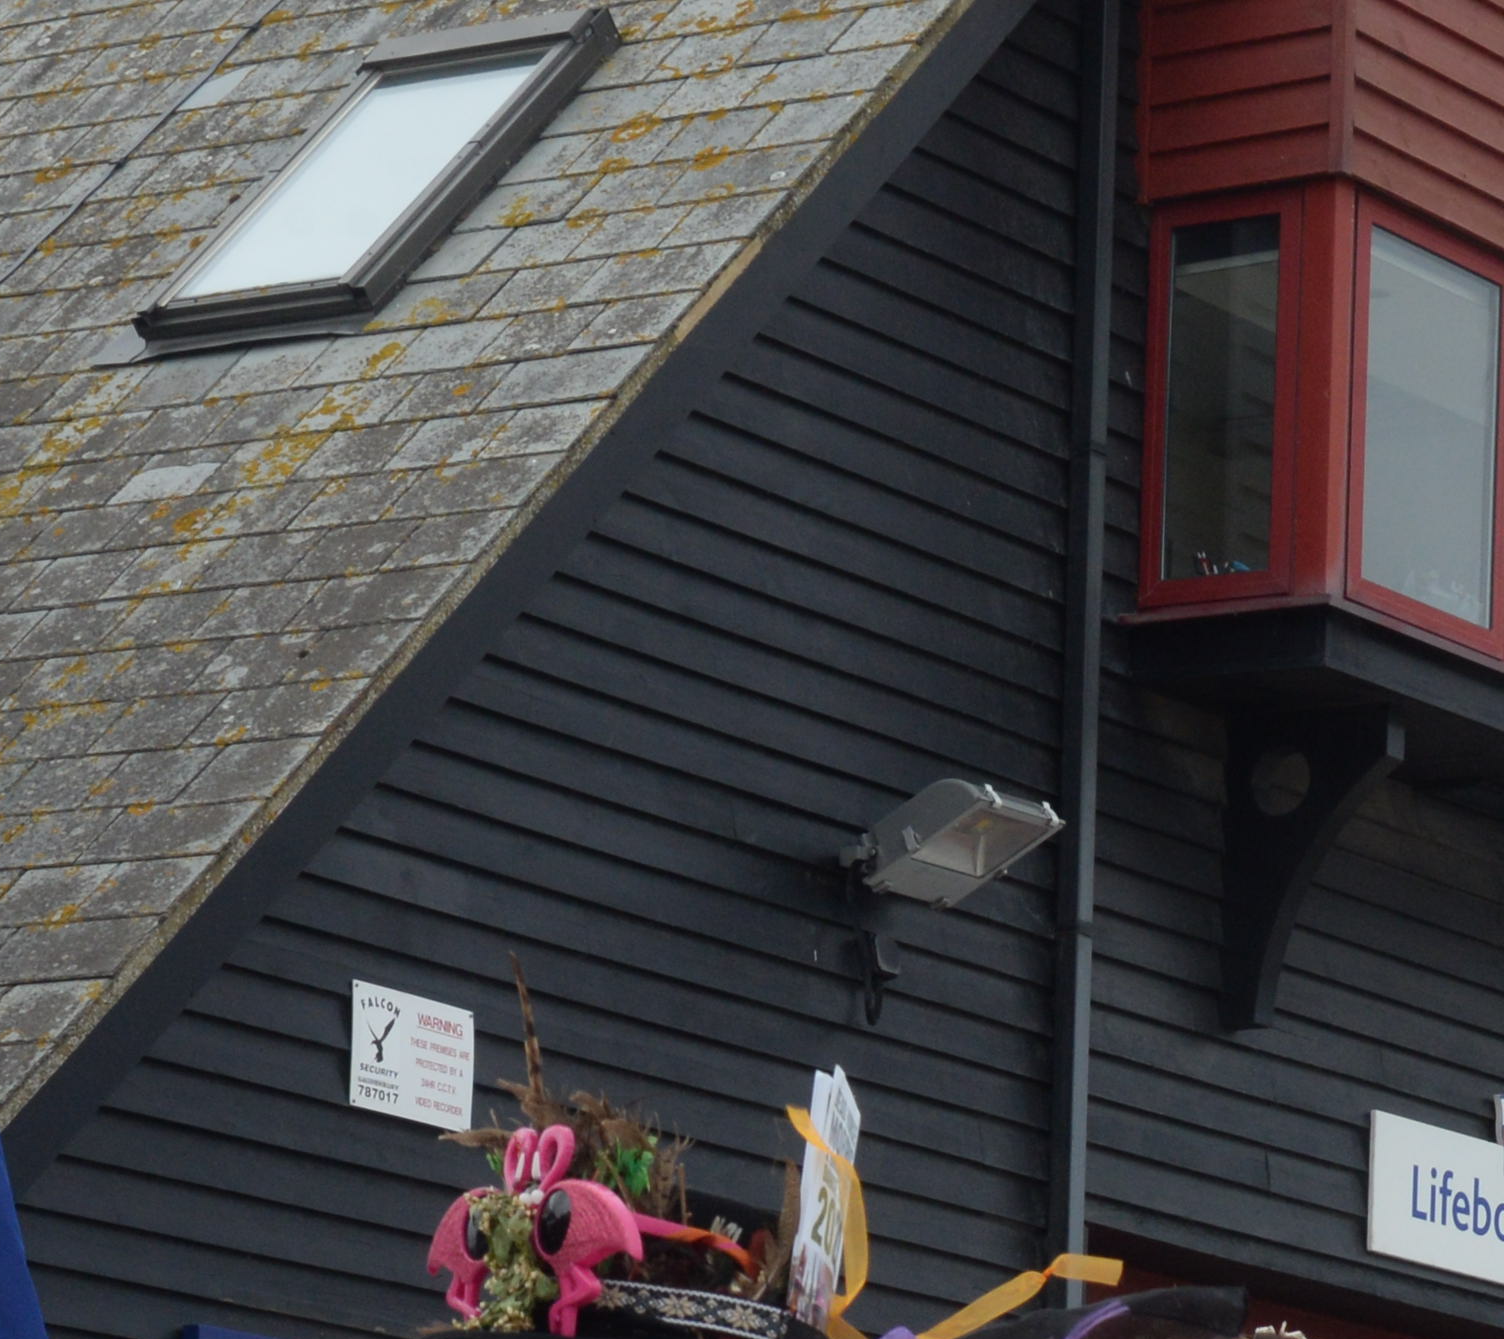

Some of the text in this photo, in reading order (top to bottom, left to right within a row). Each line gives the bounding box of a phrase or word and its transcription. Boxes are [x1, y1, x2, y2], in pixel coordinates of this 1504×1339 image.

[361, 996, 401, 1018] FALCON
[417, 1012, 463, 1037] WARNING
[410, 1037, 470, 1061] THESE PREMISES ARE
[359, 1063, 399, 1079] SECURITY
[415, 1057, 447, 1074] PROTECTED
[448, 1066, 458, 1077] BY
[358, 1084, 399, 1104] 787017
[415, 1096, 463, 1116] VIDEO RECORDER
